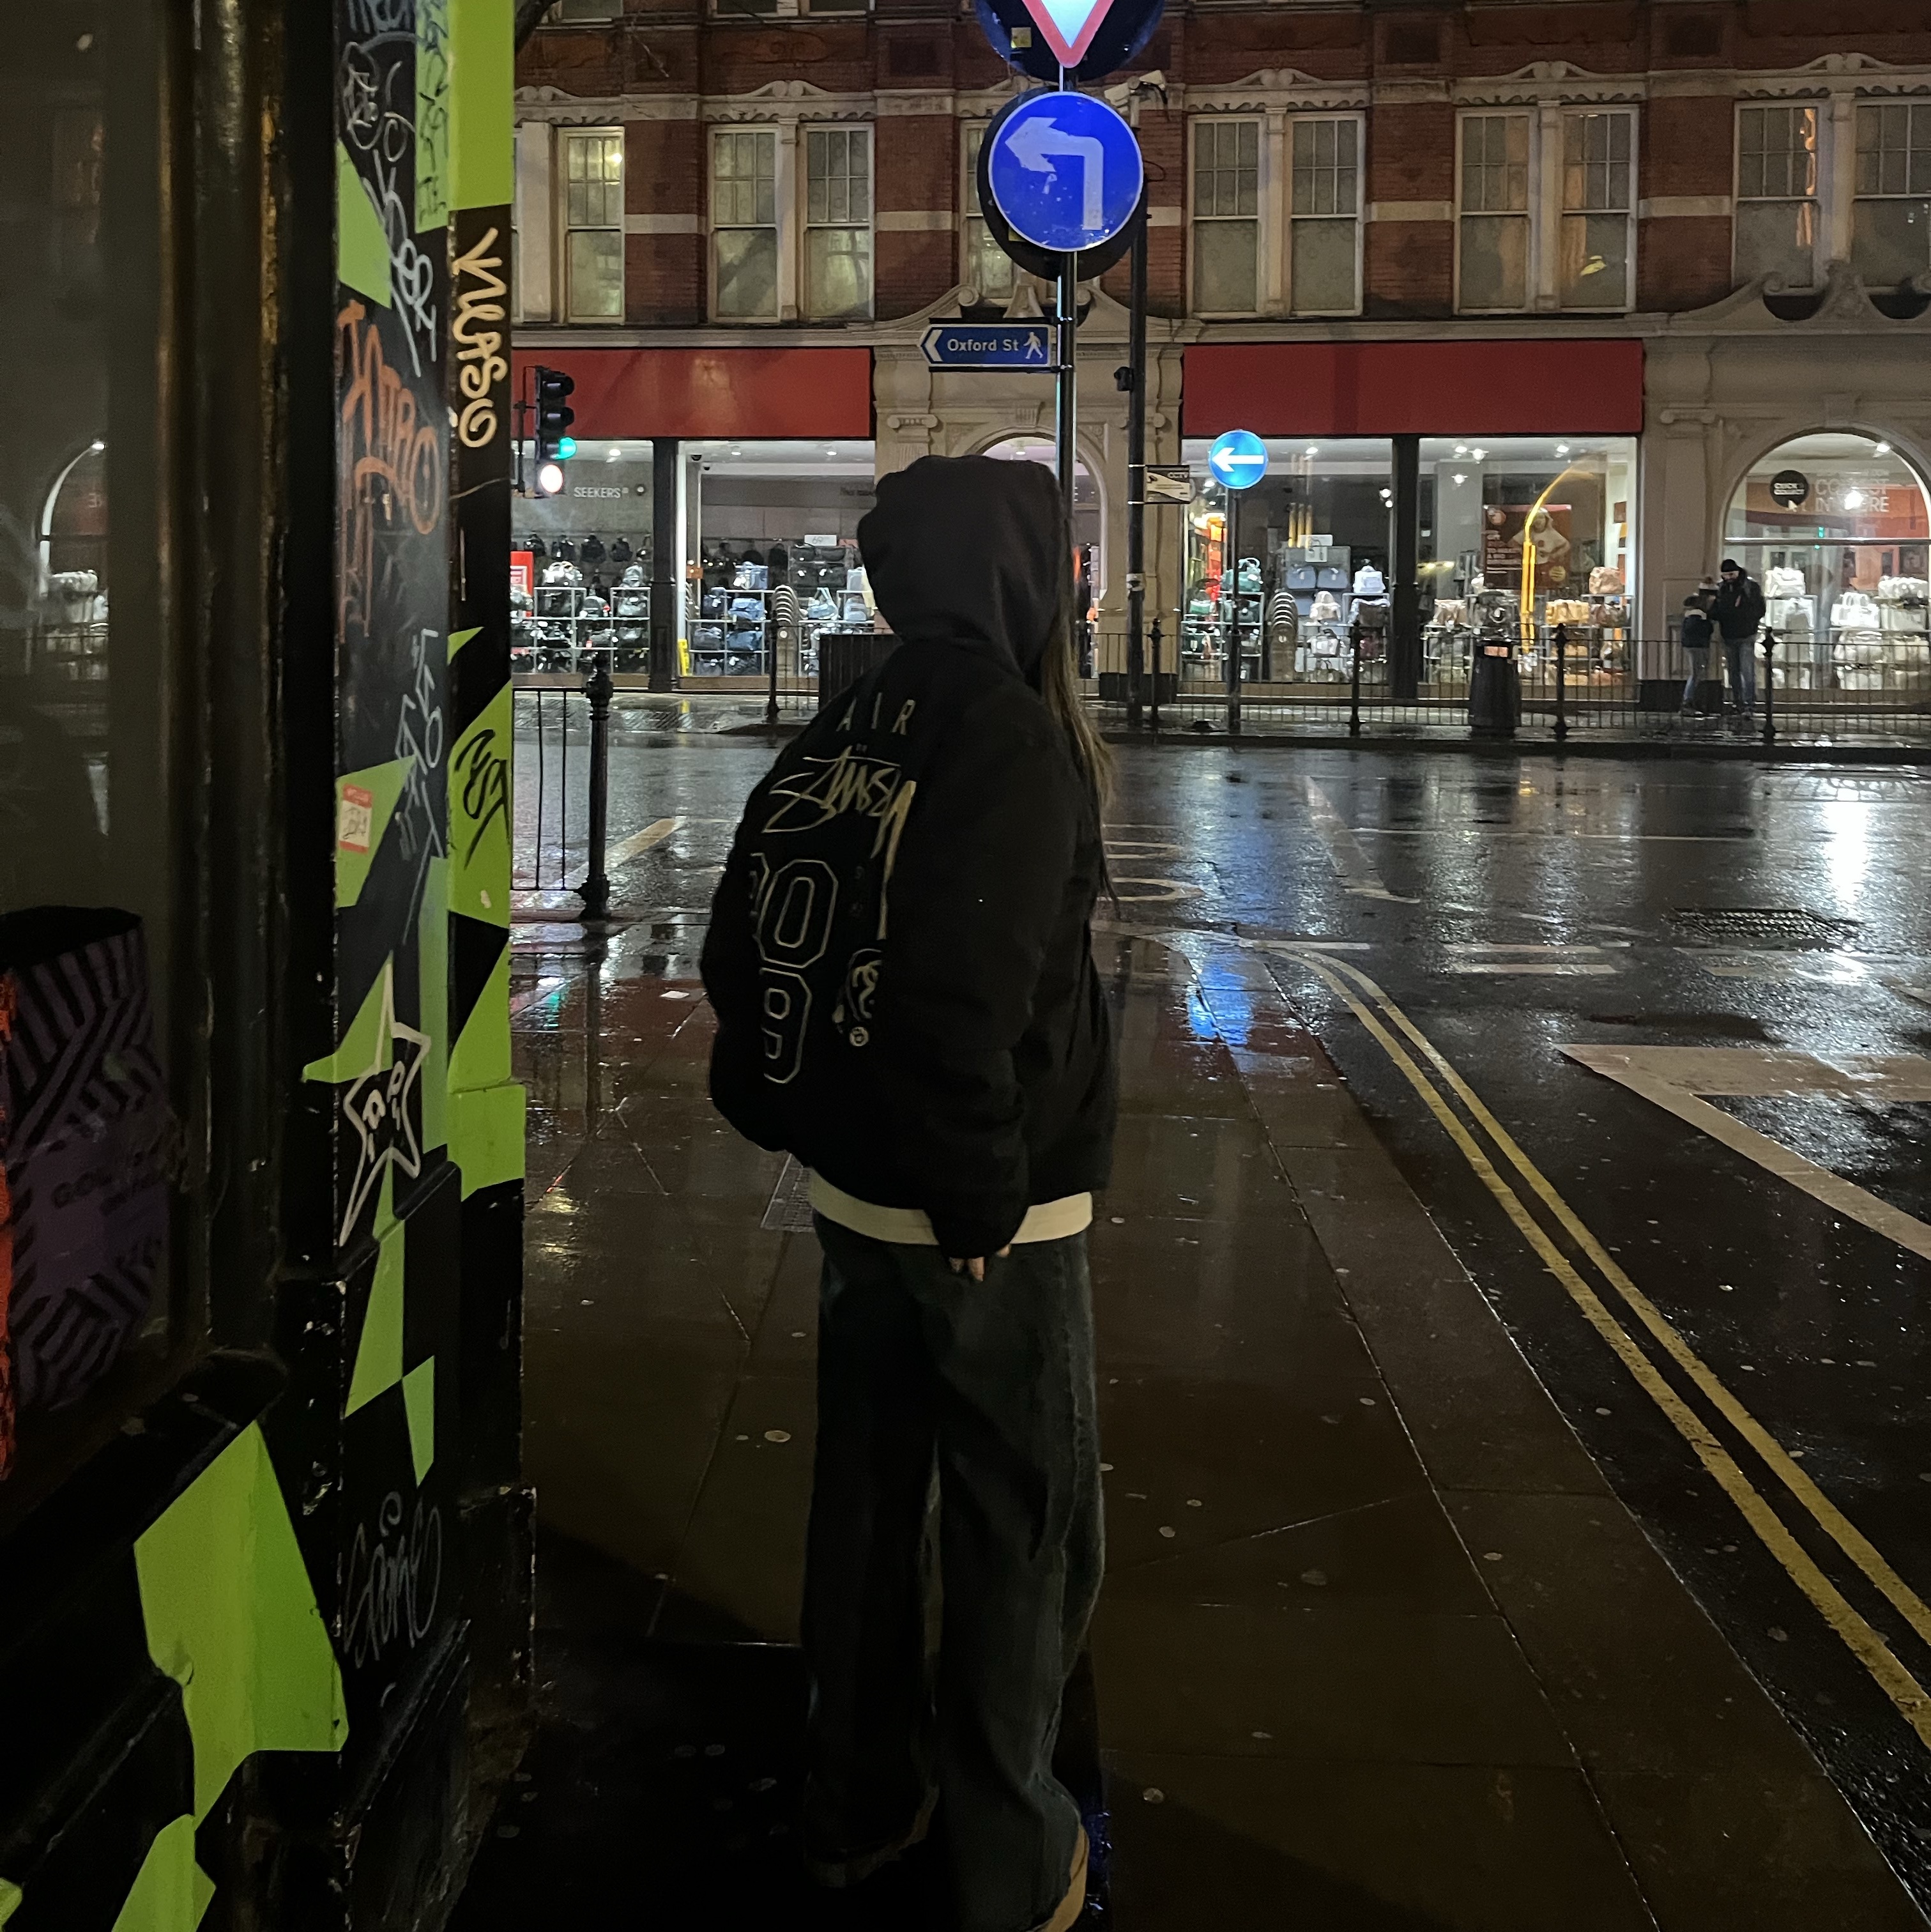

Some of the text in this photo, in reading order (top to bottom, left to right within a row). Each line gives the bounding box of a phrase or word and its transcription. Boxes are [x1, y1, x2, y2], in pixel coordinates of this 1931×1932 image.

[947, 339, 1019, 351] Oxford St
[574, 486, 621, 498] SEEKERS
[835, 691, 917, 736] AIR
